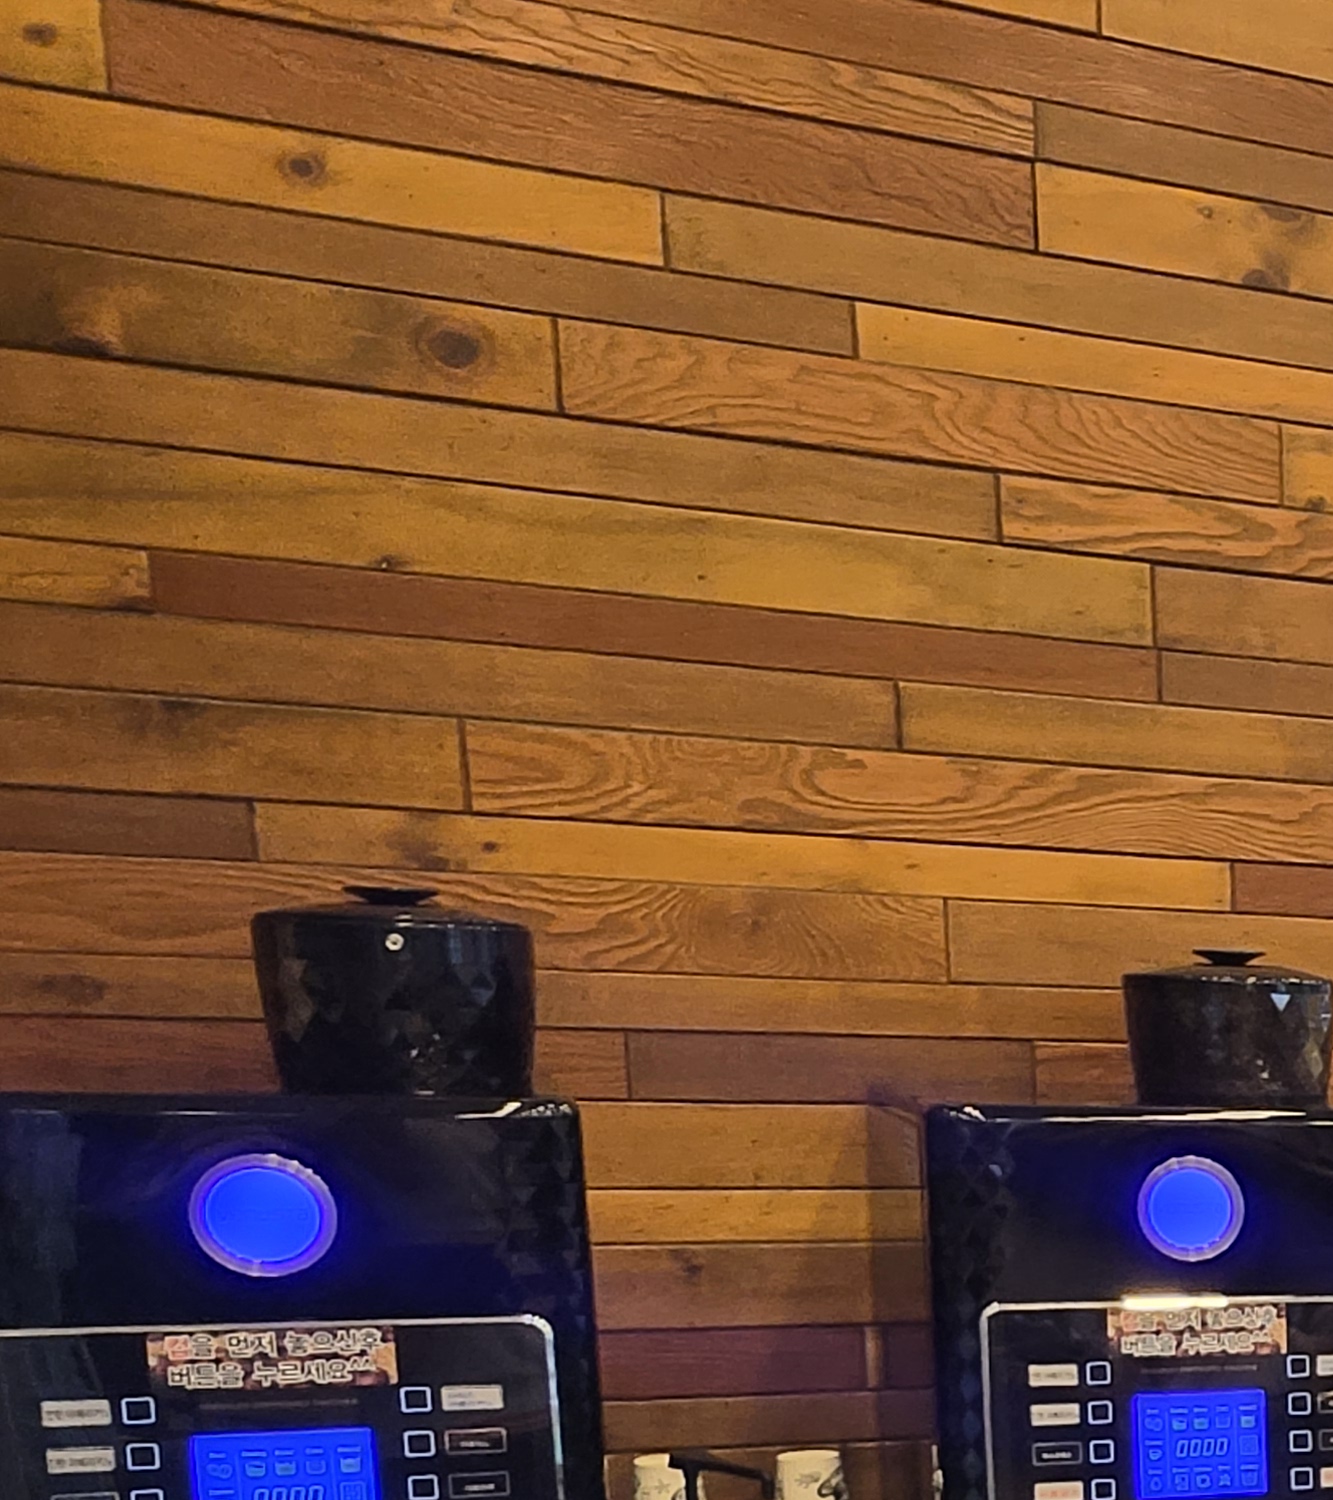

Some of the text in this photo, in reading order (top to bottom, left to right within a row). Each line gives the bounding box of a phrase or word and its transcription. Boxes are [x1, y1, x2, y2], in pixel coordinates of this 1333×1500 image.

[226, 1331, 279, 1358] 먼저
[285, 1328, 382, 1356] 놓으신후
[167, 1361, 245, 1389] 버튼을
[1176, 1438, 1229, 1458] 0000
